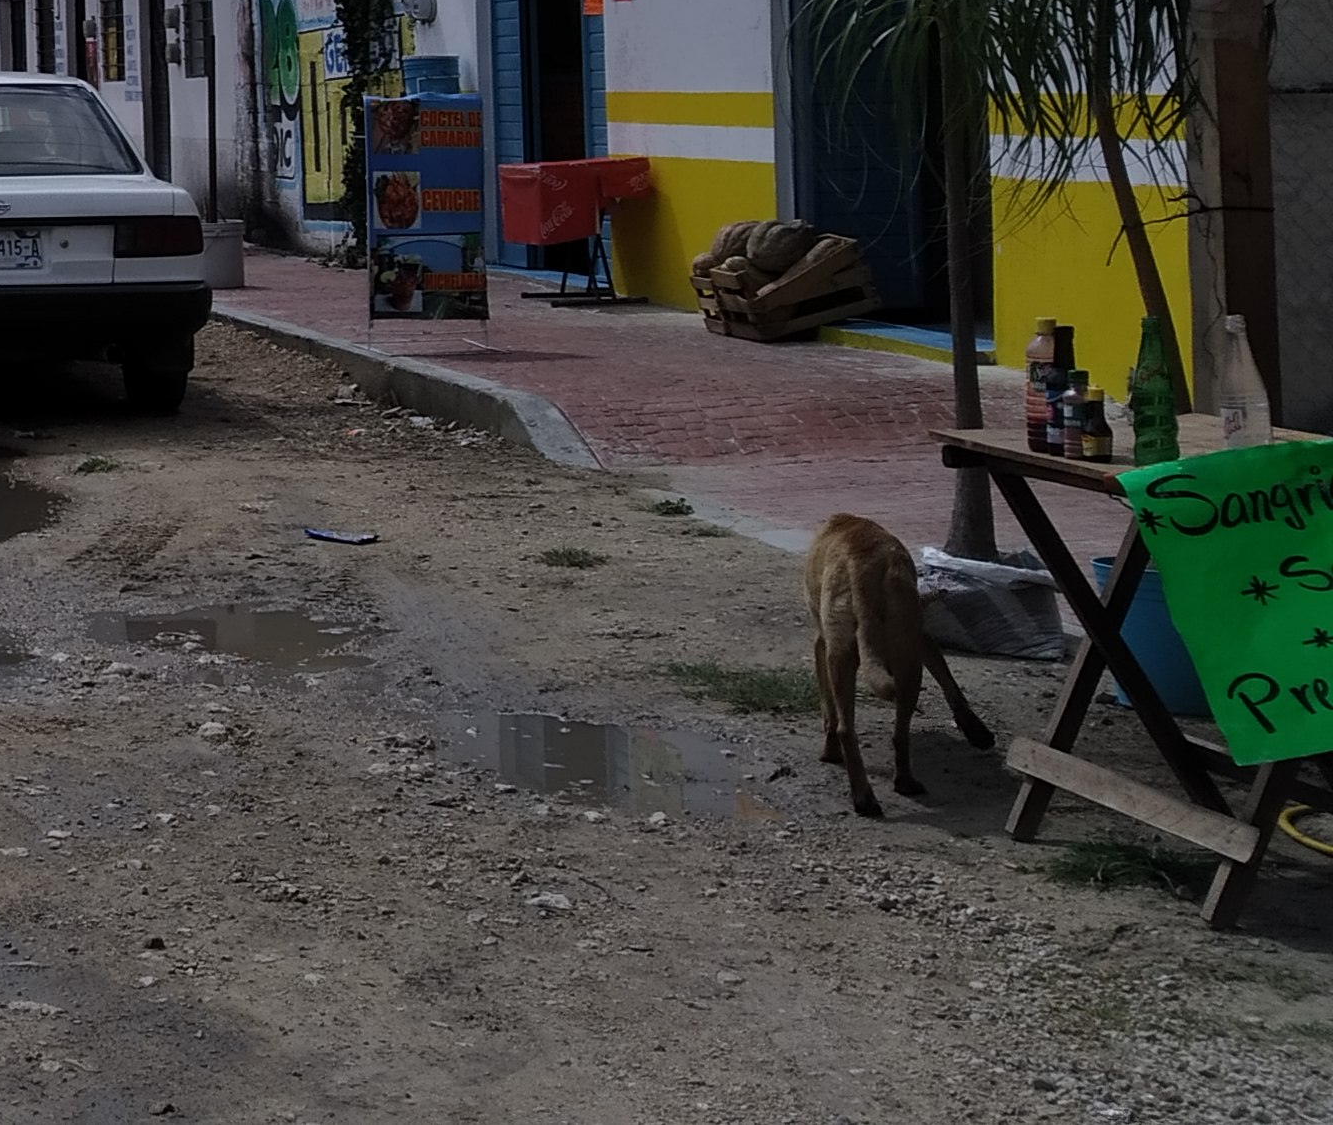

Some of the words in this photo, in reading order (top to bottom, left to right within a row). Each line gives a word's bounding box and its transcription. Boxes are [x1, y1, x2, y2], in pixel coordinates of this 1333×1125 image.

[420, 110, 465, 127] COCTEL
[420, 130, 481, 148] CAMARON
[422, 189, 480, 212] CEVICHE
